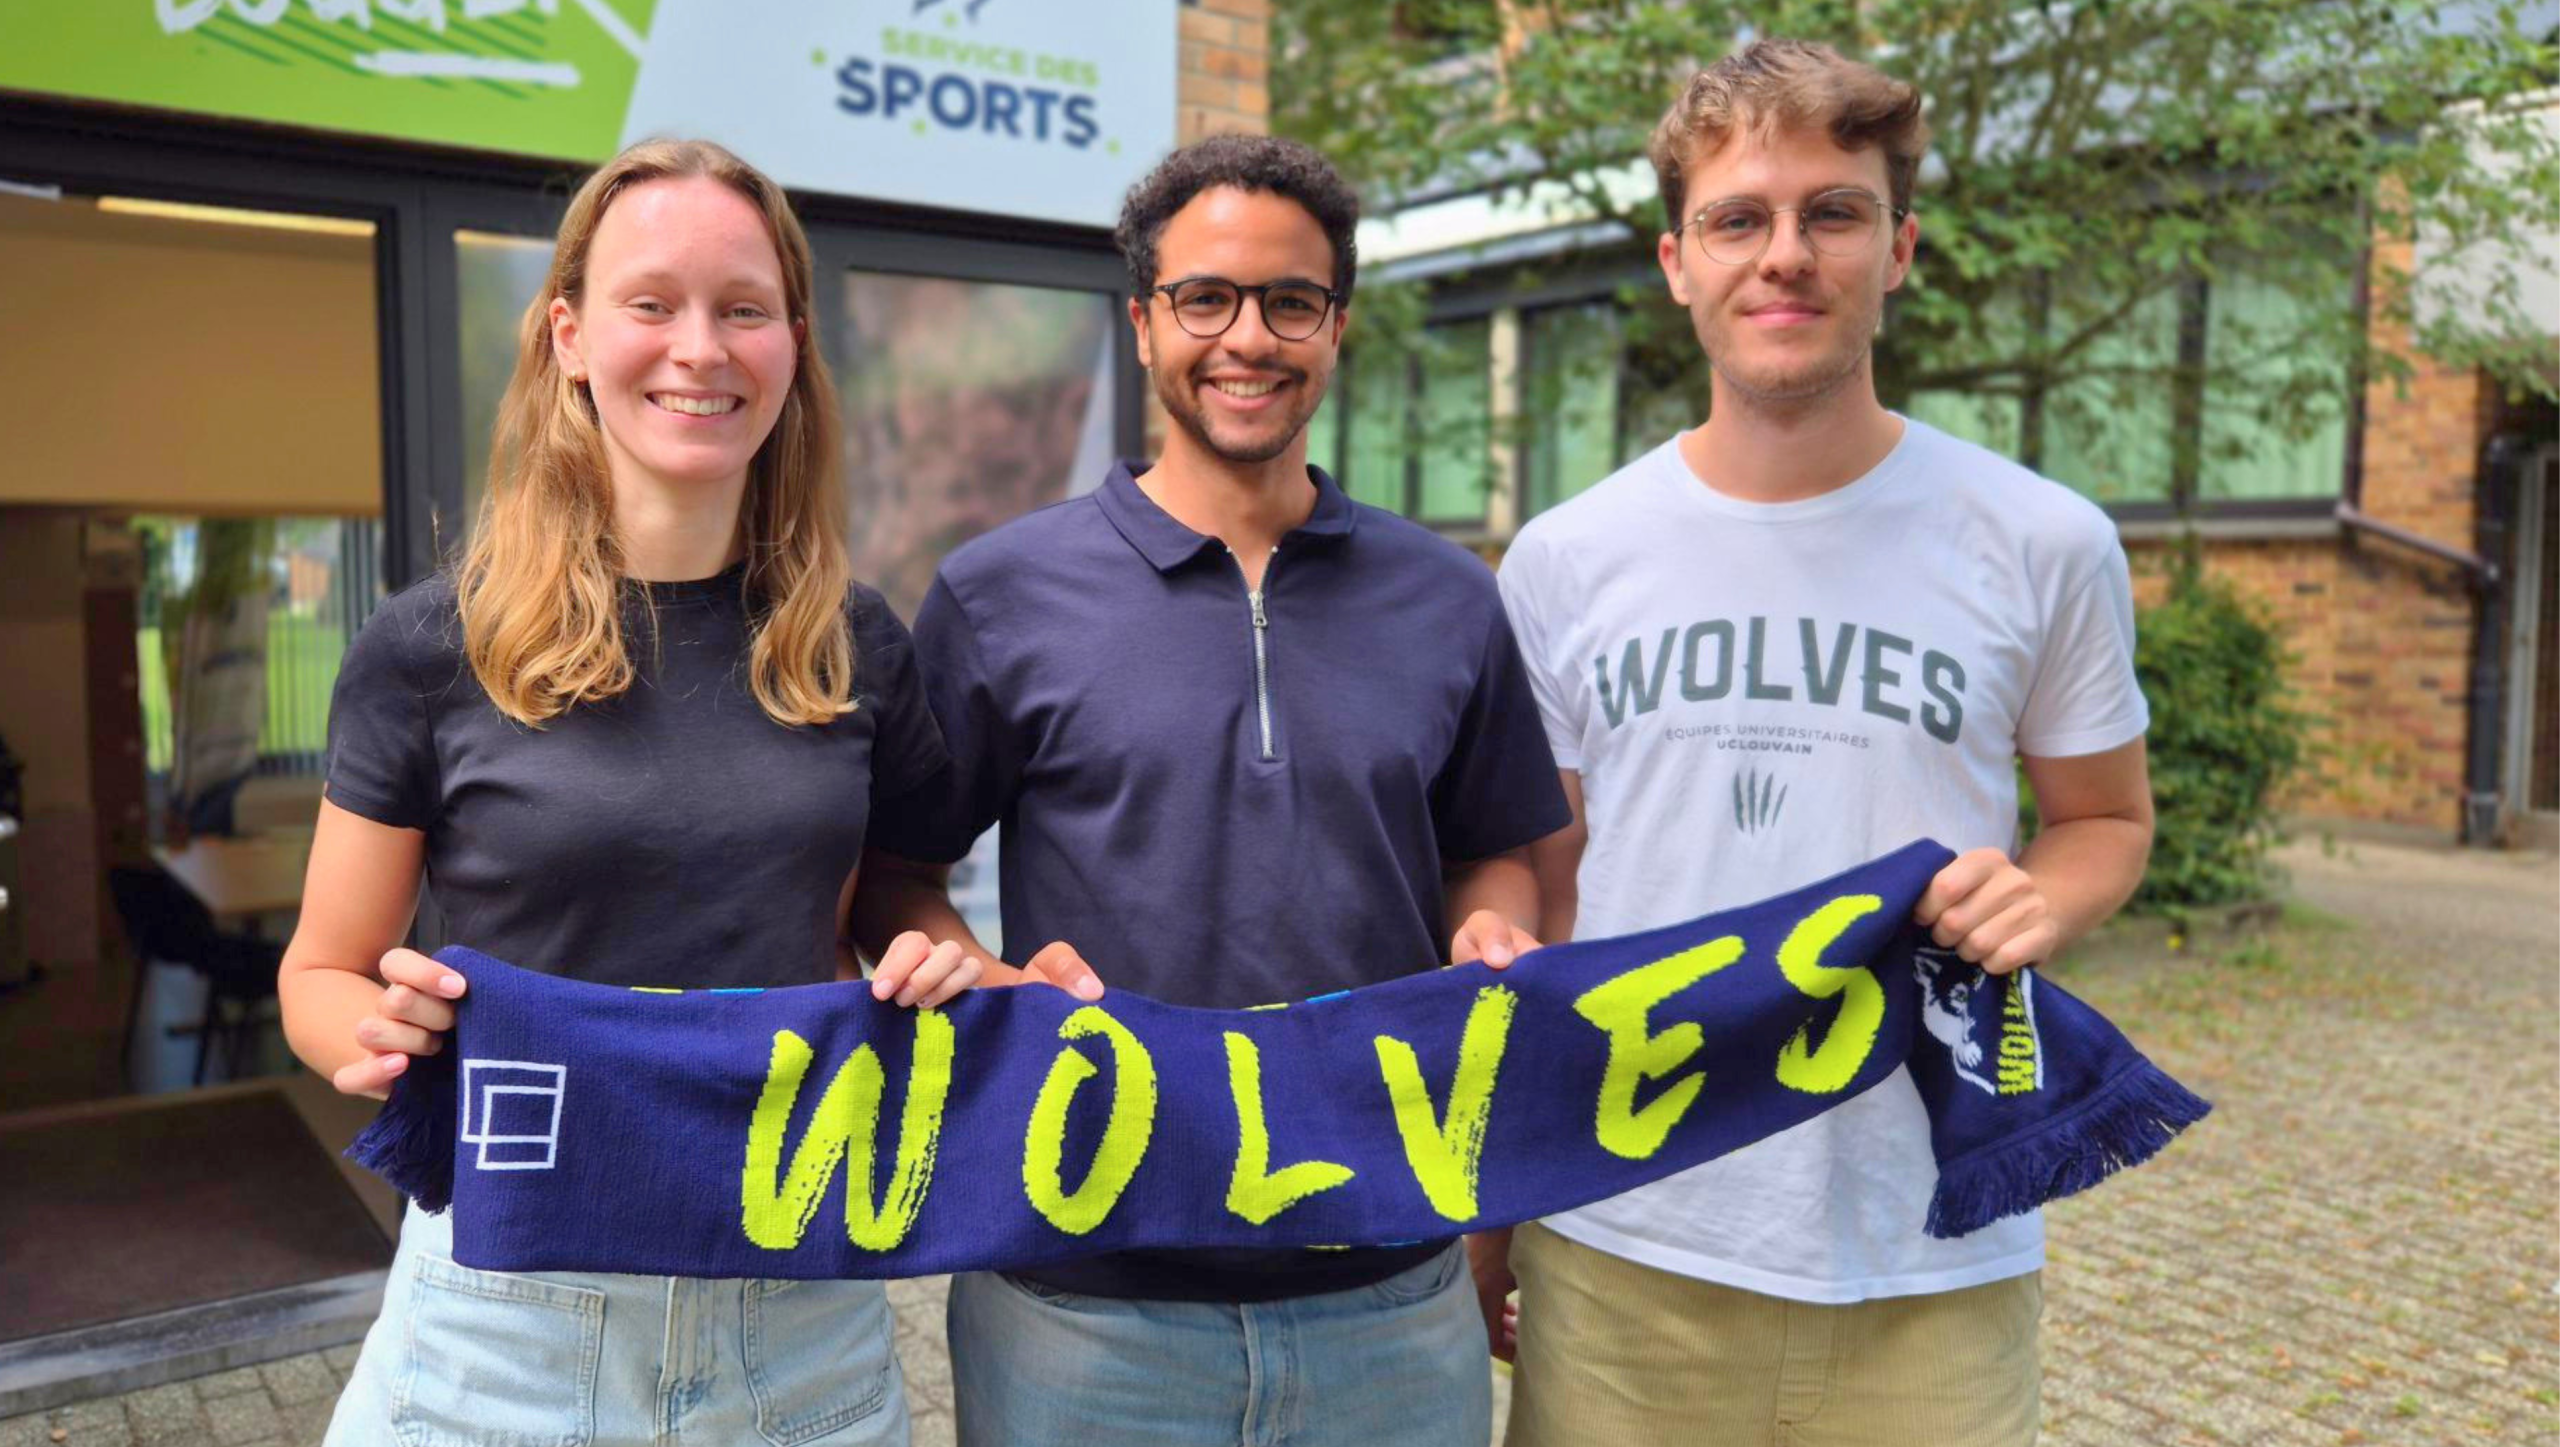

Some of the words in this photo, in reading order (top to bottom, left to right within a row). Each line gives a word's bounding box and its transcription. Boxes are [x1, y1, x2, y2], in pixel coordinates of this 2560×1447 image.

[881, 28, 1026, 76] SERVICE
[1036, 55, 1098, 88] DES
[835, 56, 1099, 150] SPORTS
[1594, 616, 1967, 745] WOLVES
[1717, 739, 1813, 755] UCLOUVAIN
[1737, 725, 1870, 749] UNIVERSITAIRES
[744, 896, 1884, 1250] WOLVES
